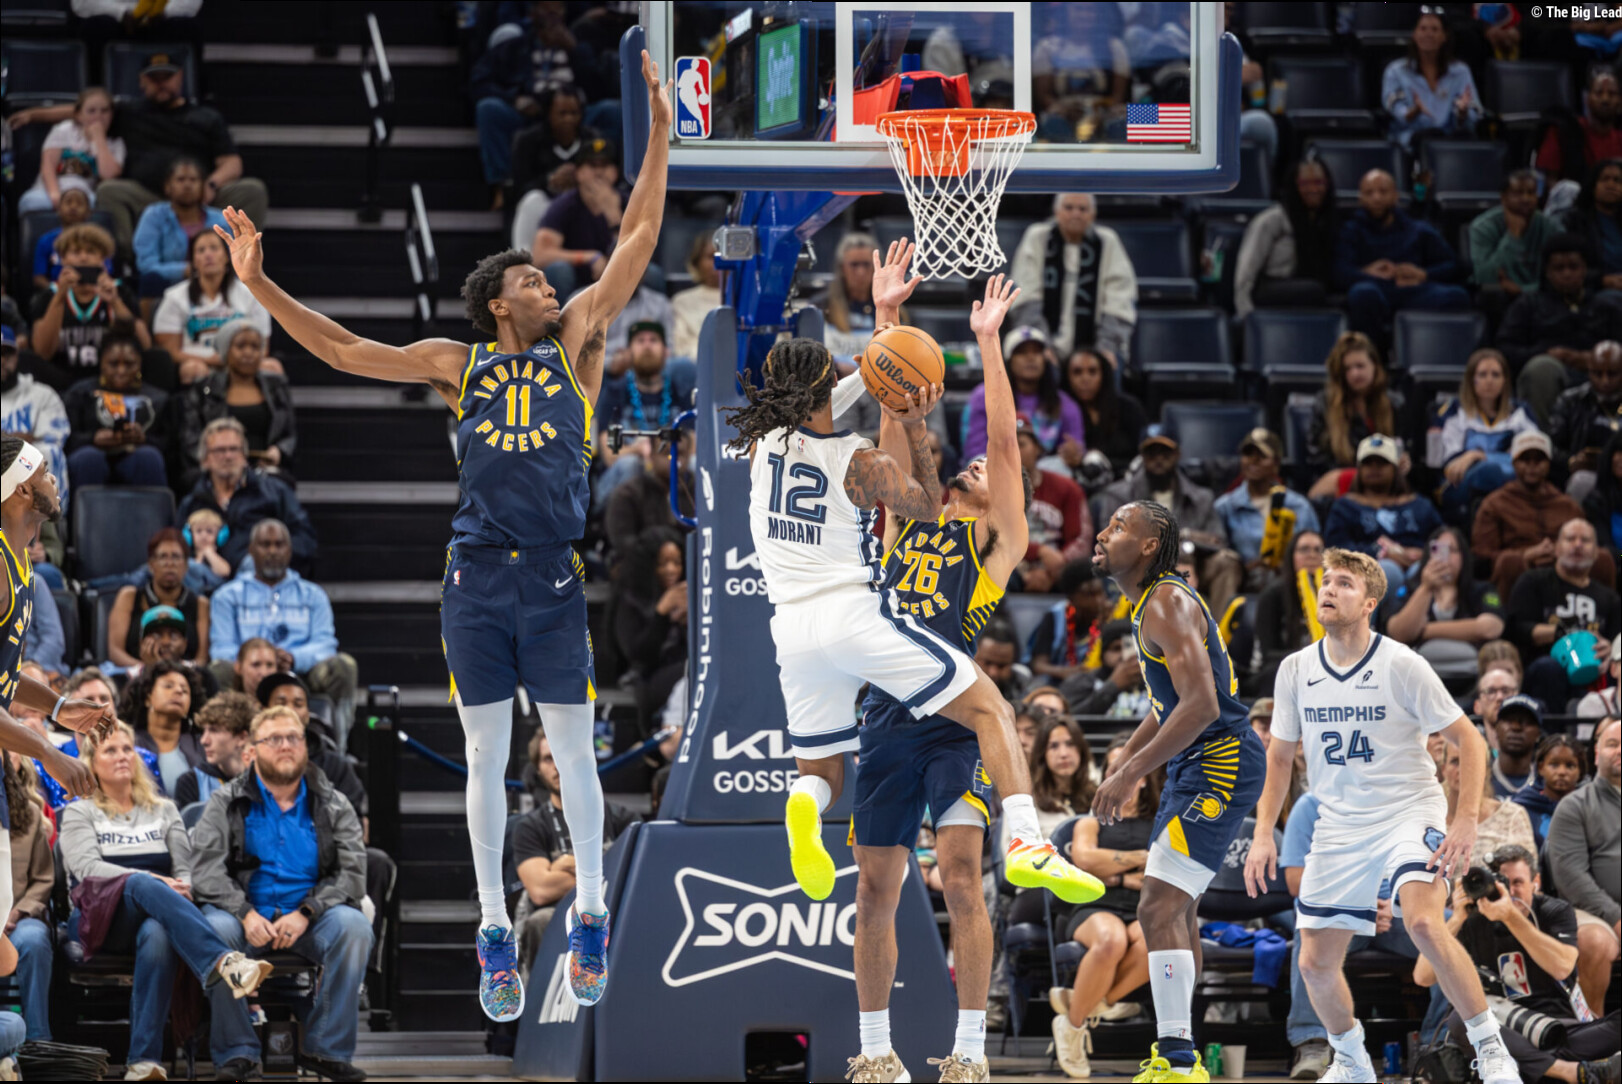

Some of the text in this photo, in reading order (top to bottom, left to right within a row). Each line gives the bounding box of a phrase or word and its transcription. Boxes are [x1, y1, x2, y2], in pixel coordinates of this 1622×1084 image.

[680, 120, 698, 134] NBA
[473, 359, 562, 400] INDIANA
[876, 352, 920, 396] Wilson
[505, 385, 530, 427] 11
[475, 419, 558, 453] PACERS
[768, 452, 829, 525] 12
[768, 516, 823, 546] MORANT
[1556, 592, 1597, 624] JA
[677, 526, 713, 763] Robinhood
[1304, 705, 1387, 723] MEMPHIS
[1321, 730, 1375, 766] 24
[713, 770, 801, 794] GOSSE
[96, 829, 165, 845] RIZZLIE
